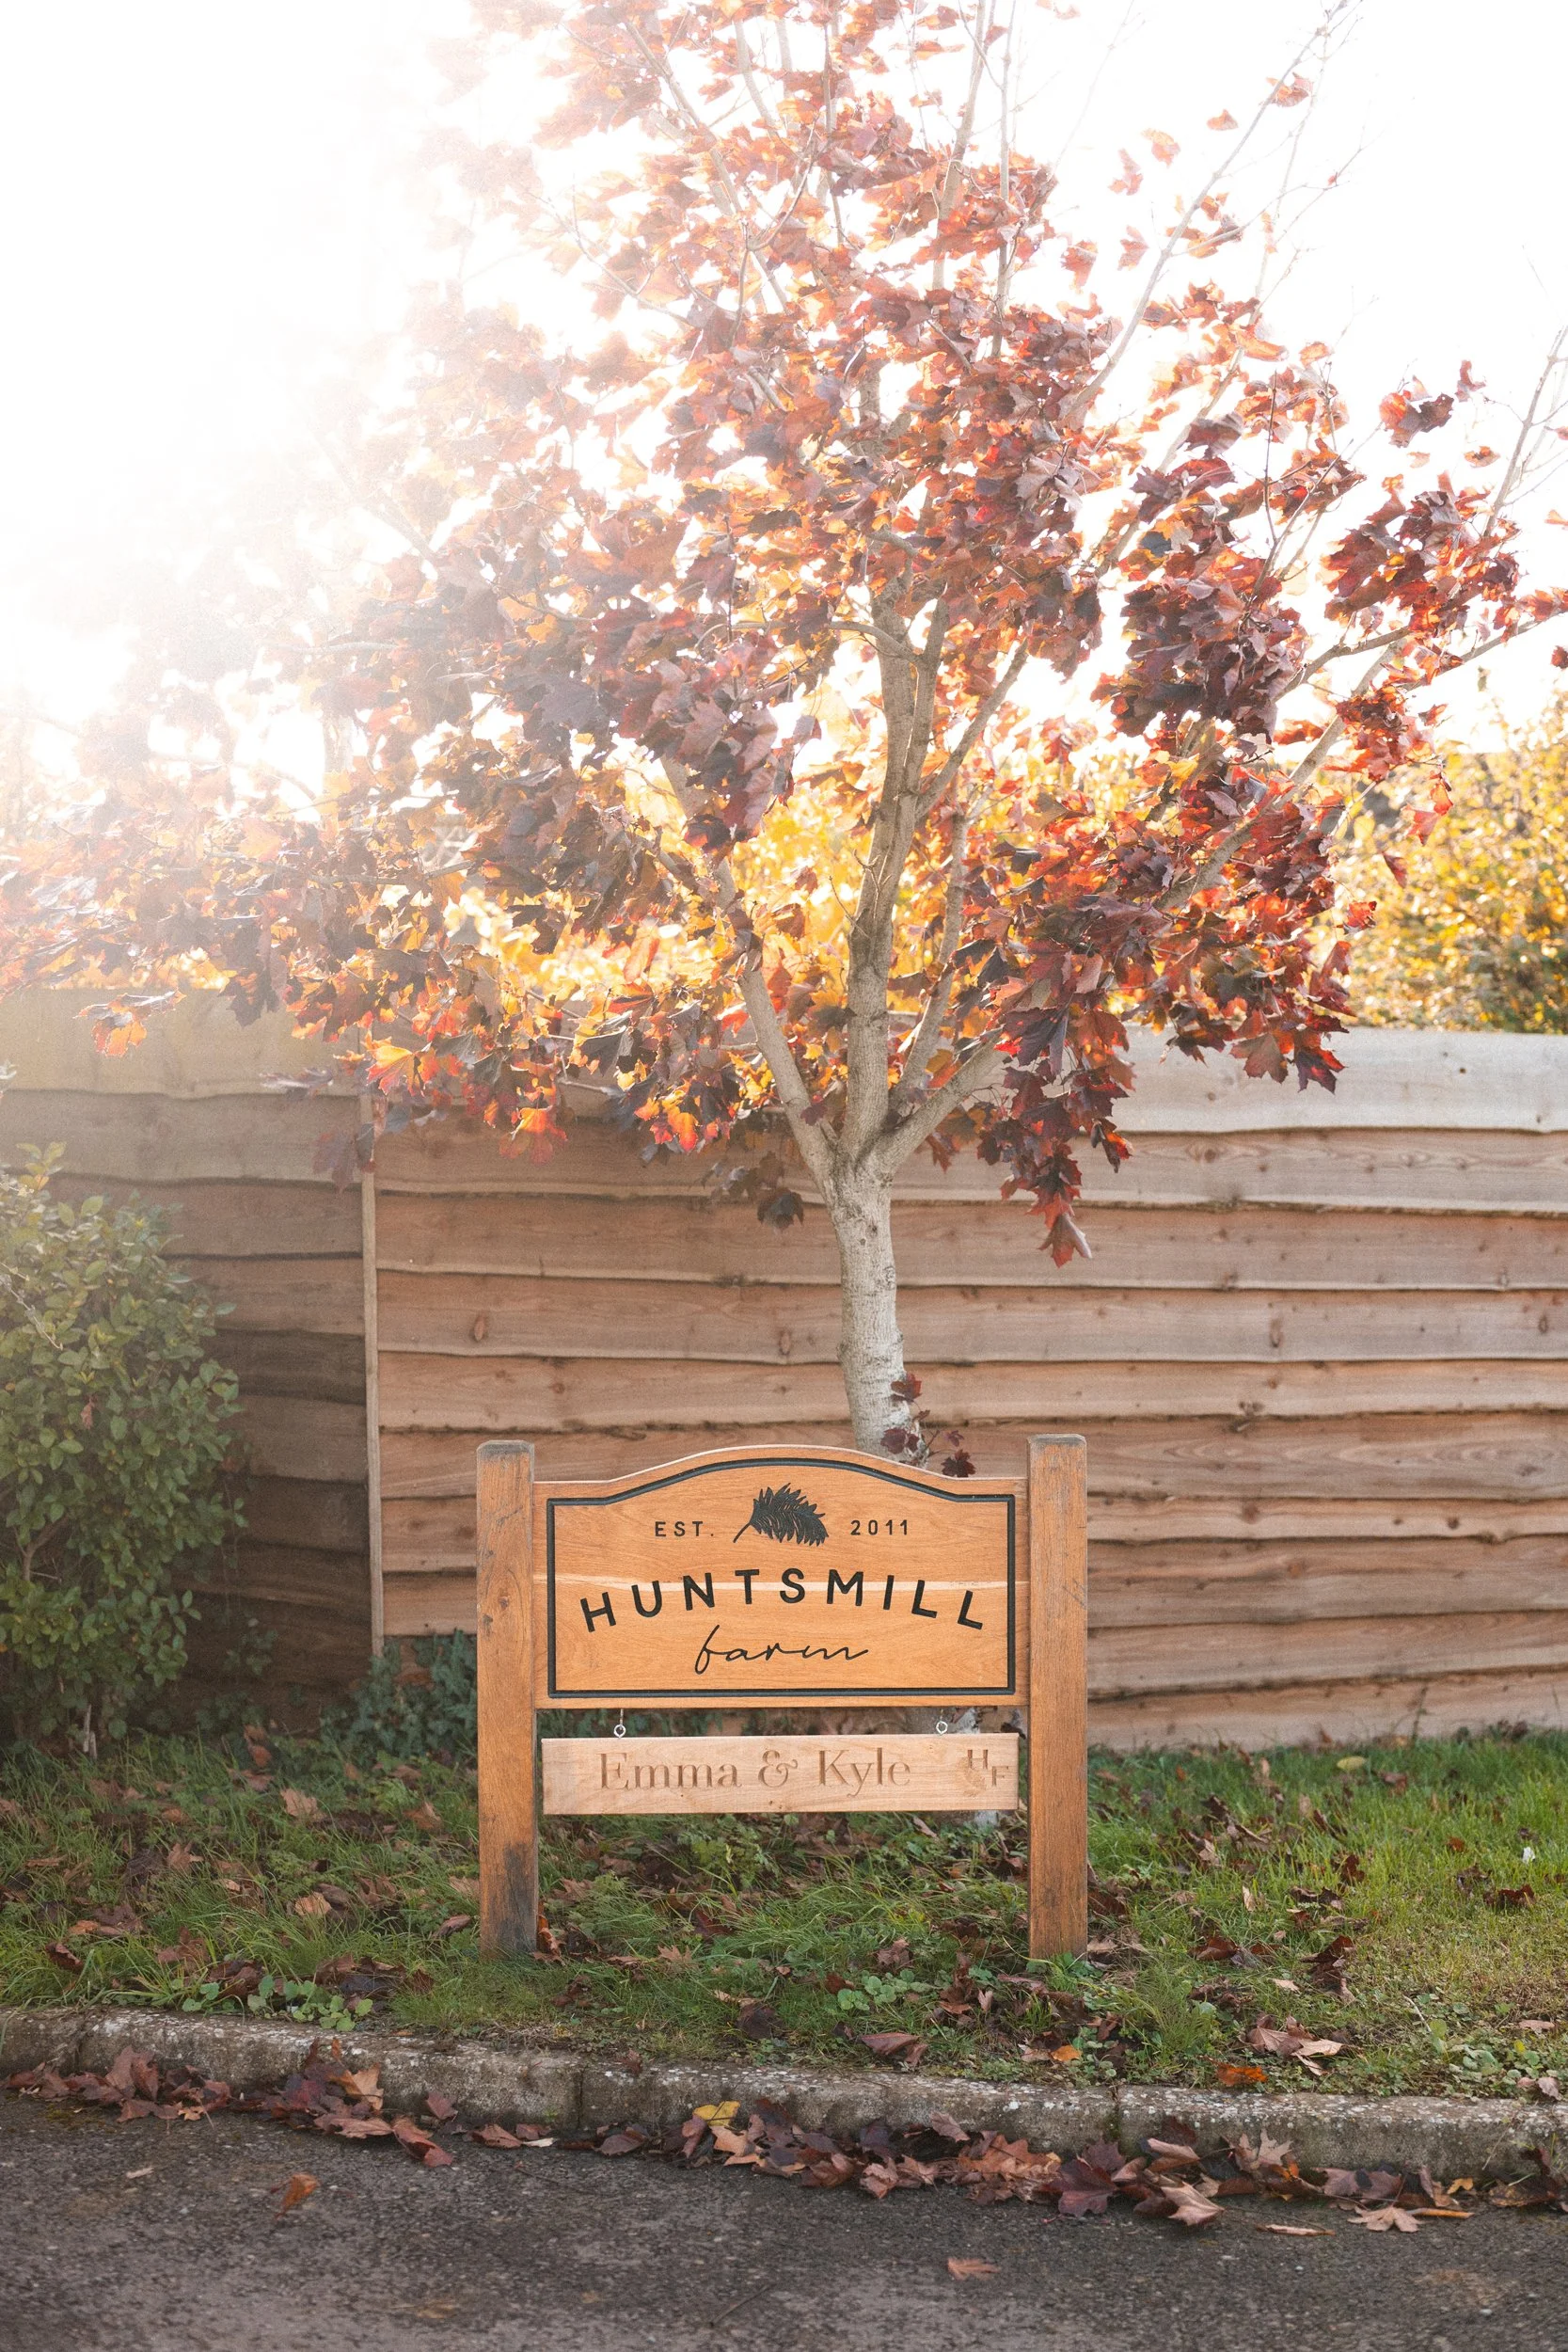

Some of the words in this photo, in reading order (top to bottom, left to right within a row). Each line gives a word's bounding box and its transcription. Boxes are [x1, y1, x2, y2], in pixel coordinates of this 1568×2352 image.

[655, 1520, 714, 1537] EST.
[850, 1518, 909, 1535] 2011
[579, 1567, 984, 1632] HUNTSMILL
[694, 1625, 869, 1675] farm
[596, 1751, 742, 1789] Emma
[757, 1749, 799, 1788] &
[817, 1747, 911, 1797] Kyle
